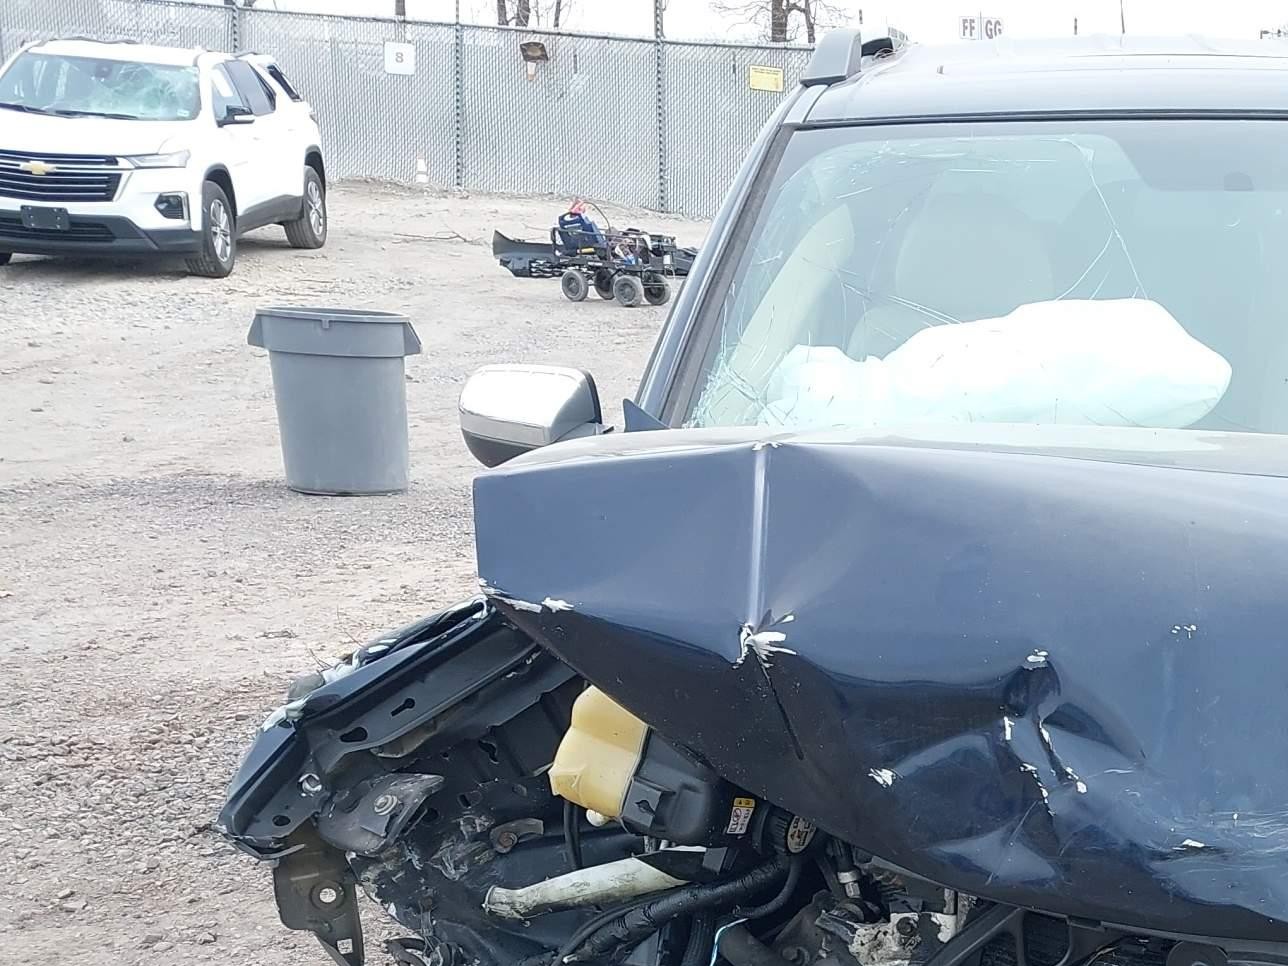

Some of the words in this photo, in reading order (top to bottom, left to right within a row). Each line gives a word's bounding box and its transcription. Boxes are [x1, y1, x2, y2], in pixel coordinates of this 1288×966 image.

[962, 18, 975, 37] FF
[985, 19, 1002, 39] GG
[395, 51, 404, 63] 8
